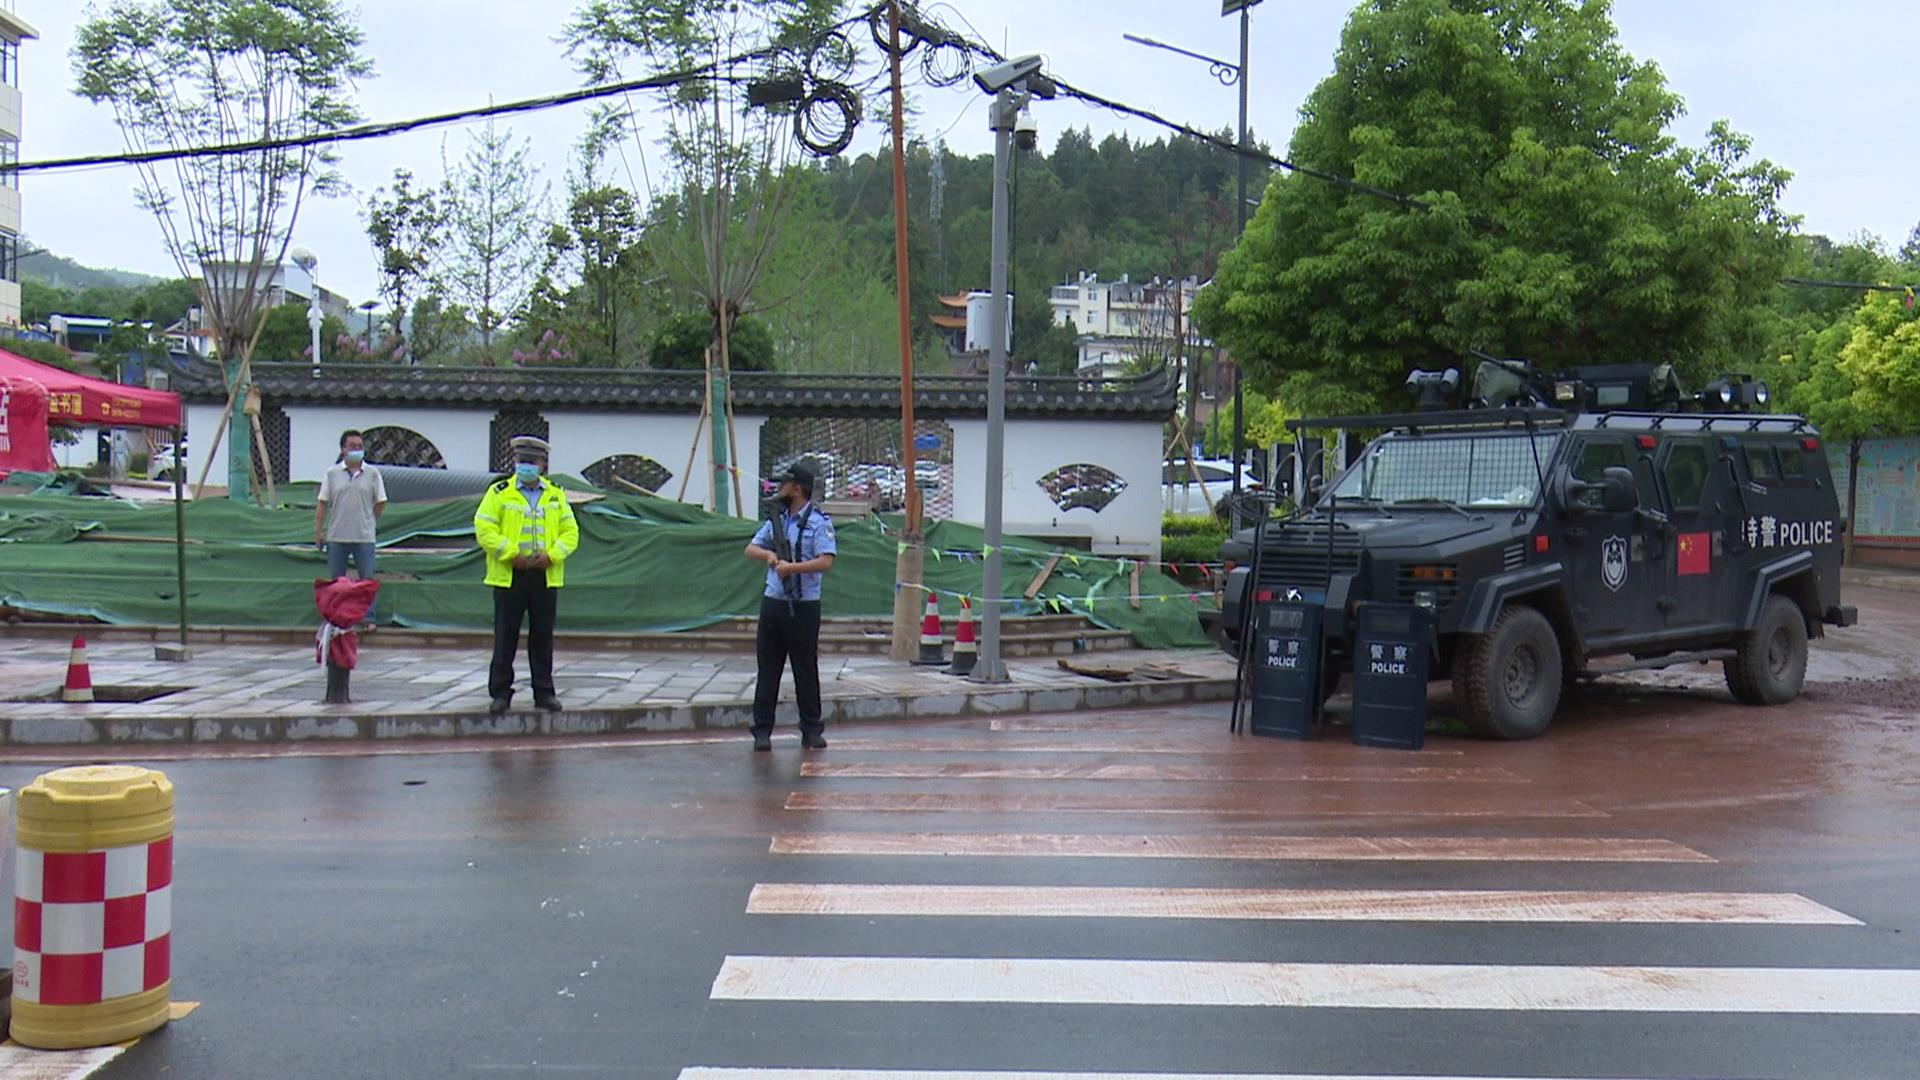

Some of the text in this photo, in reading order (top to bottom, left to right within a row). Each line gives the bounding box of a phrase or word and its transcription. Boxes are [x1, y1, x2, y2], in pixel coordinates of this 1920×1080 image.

[1781, 521, 1832, 546] POLICE
[1268, 639, 1299, 655] 警察
[1371, 644, 1408, 660] 警察
[1268, 655, 1297, 667] POLICE
[1371, 663, 1405, 674] POLICE
